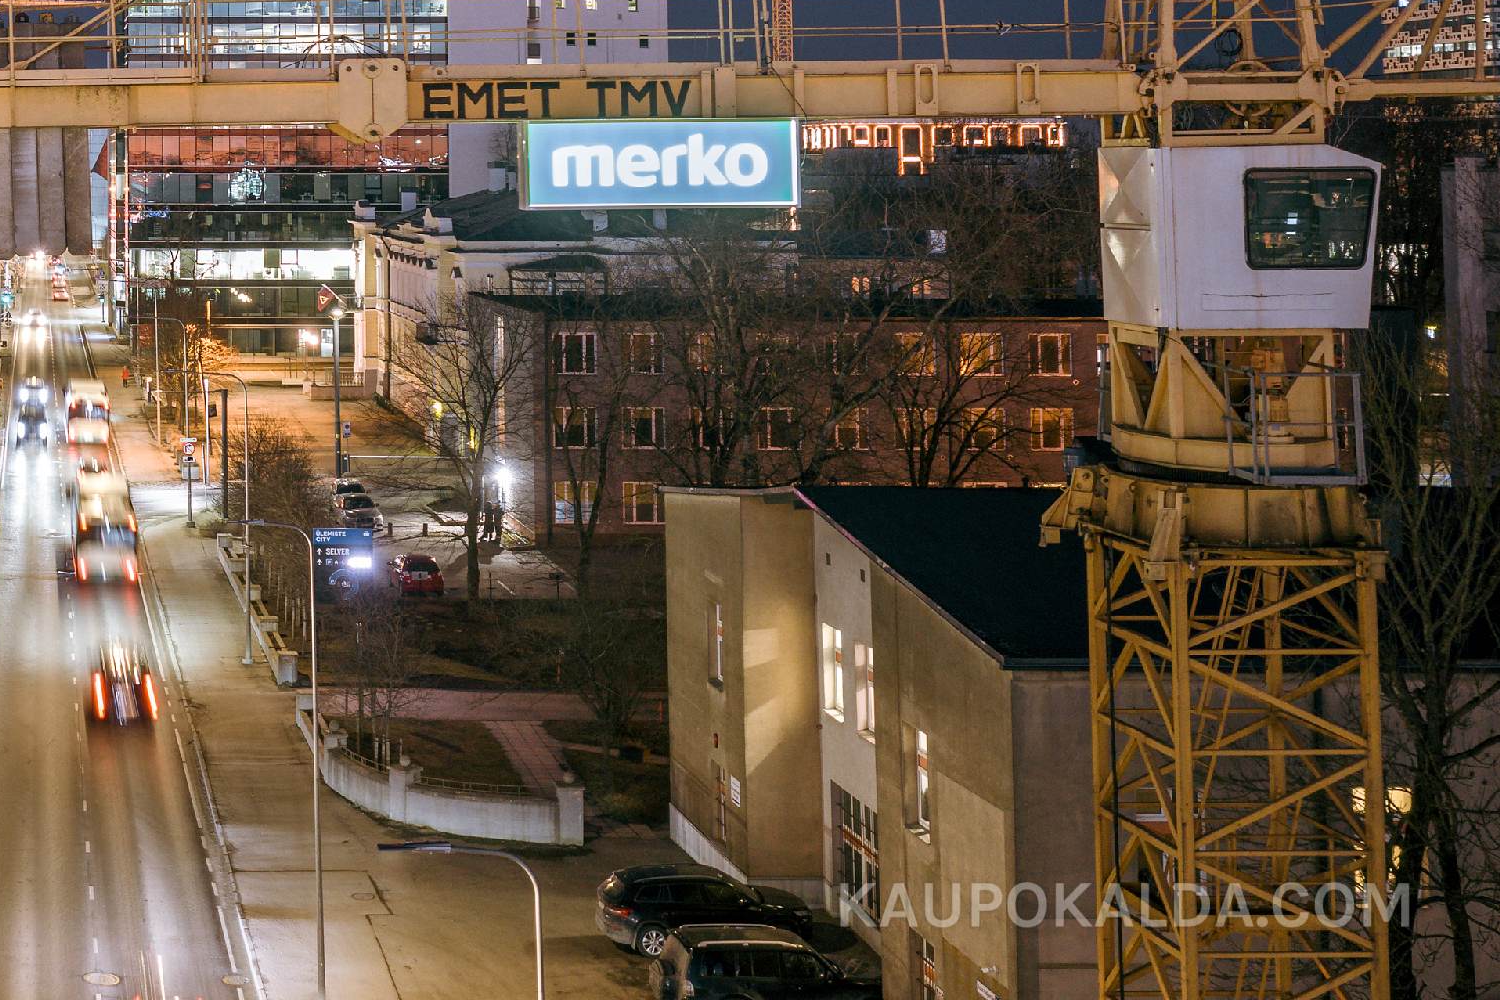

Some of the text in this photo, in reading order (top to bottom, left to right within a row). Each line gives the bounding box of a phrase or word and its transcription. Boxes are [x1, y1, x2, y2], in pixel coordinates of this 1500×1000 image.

[423, 80, 691, 119] EMET TMV
[551, 132, 769, 188] merko
[325, 547, 350, 556] SELVER
